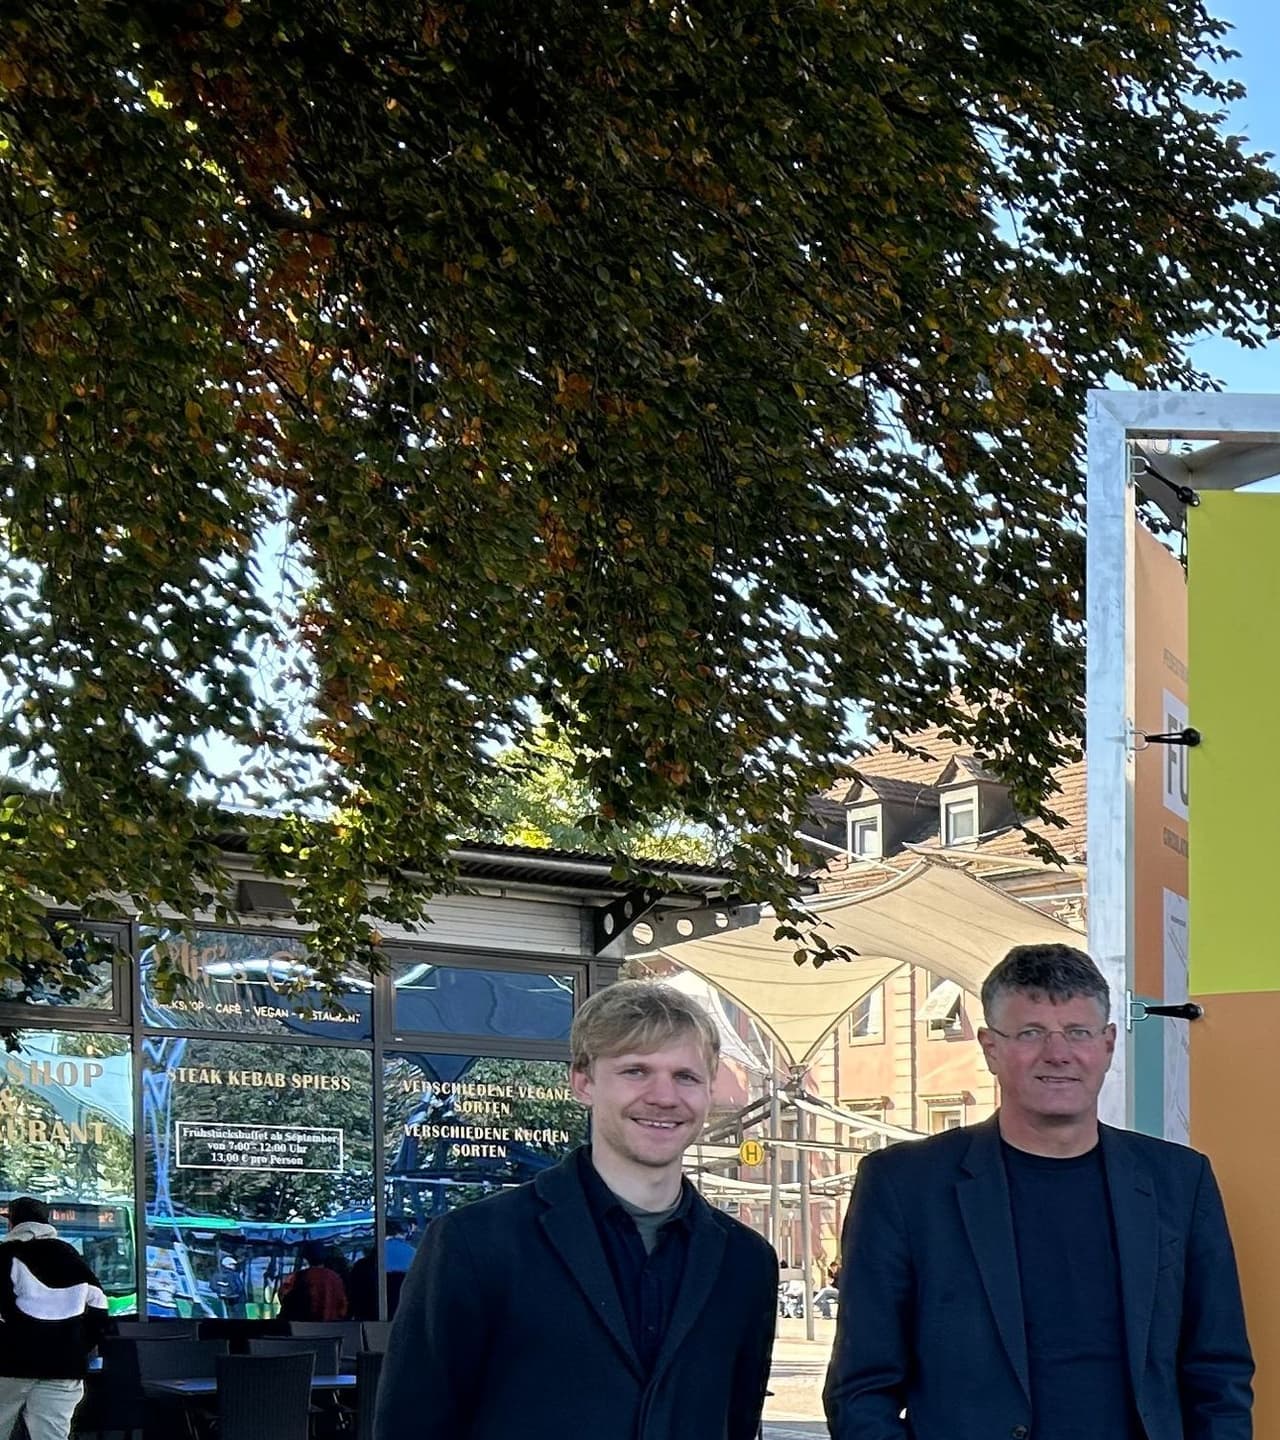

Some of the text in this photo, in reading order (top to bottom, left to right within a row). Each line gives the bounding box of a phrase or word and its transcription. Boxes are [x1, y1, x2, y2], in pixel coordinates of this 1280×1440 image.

[253, 1007, 288, 1018] VEGAN
[7, 1060, 103, 1087] SHOP
[168, 1067, 351, 1091] STEAK KEBAB SPIESS
[454, 1101, 510, 1114] SORTEN
[404, 1125, 509, 1140] VERSCHIEDENE
[452, 1144, 506, 1158] SORTEN
[746, 1145, 757, 1161] H
